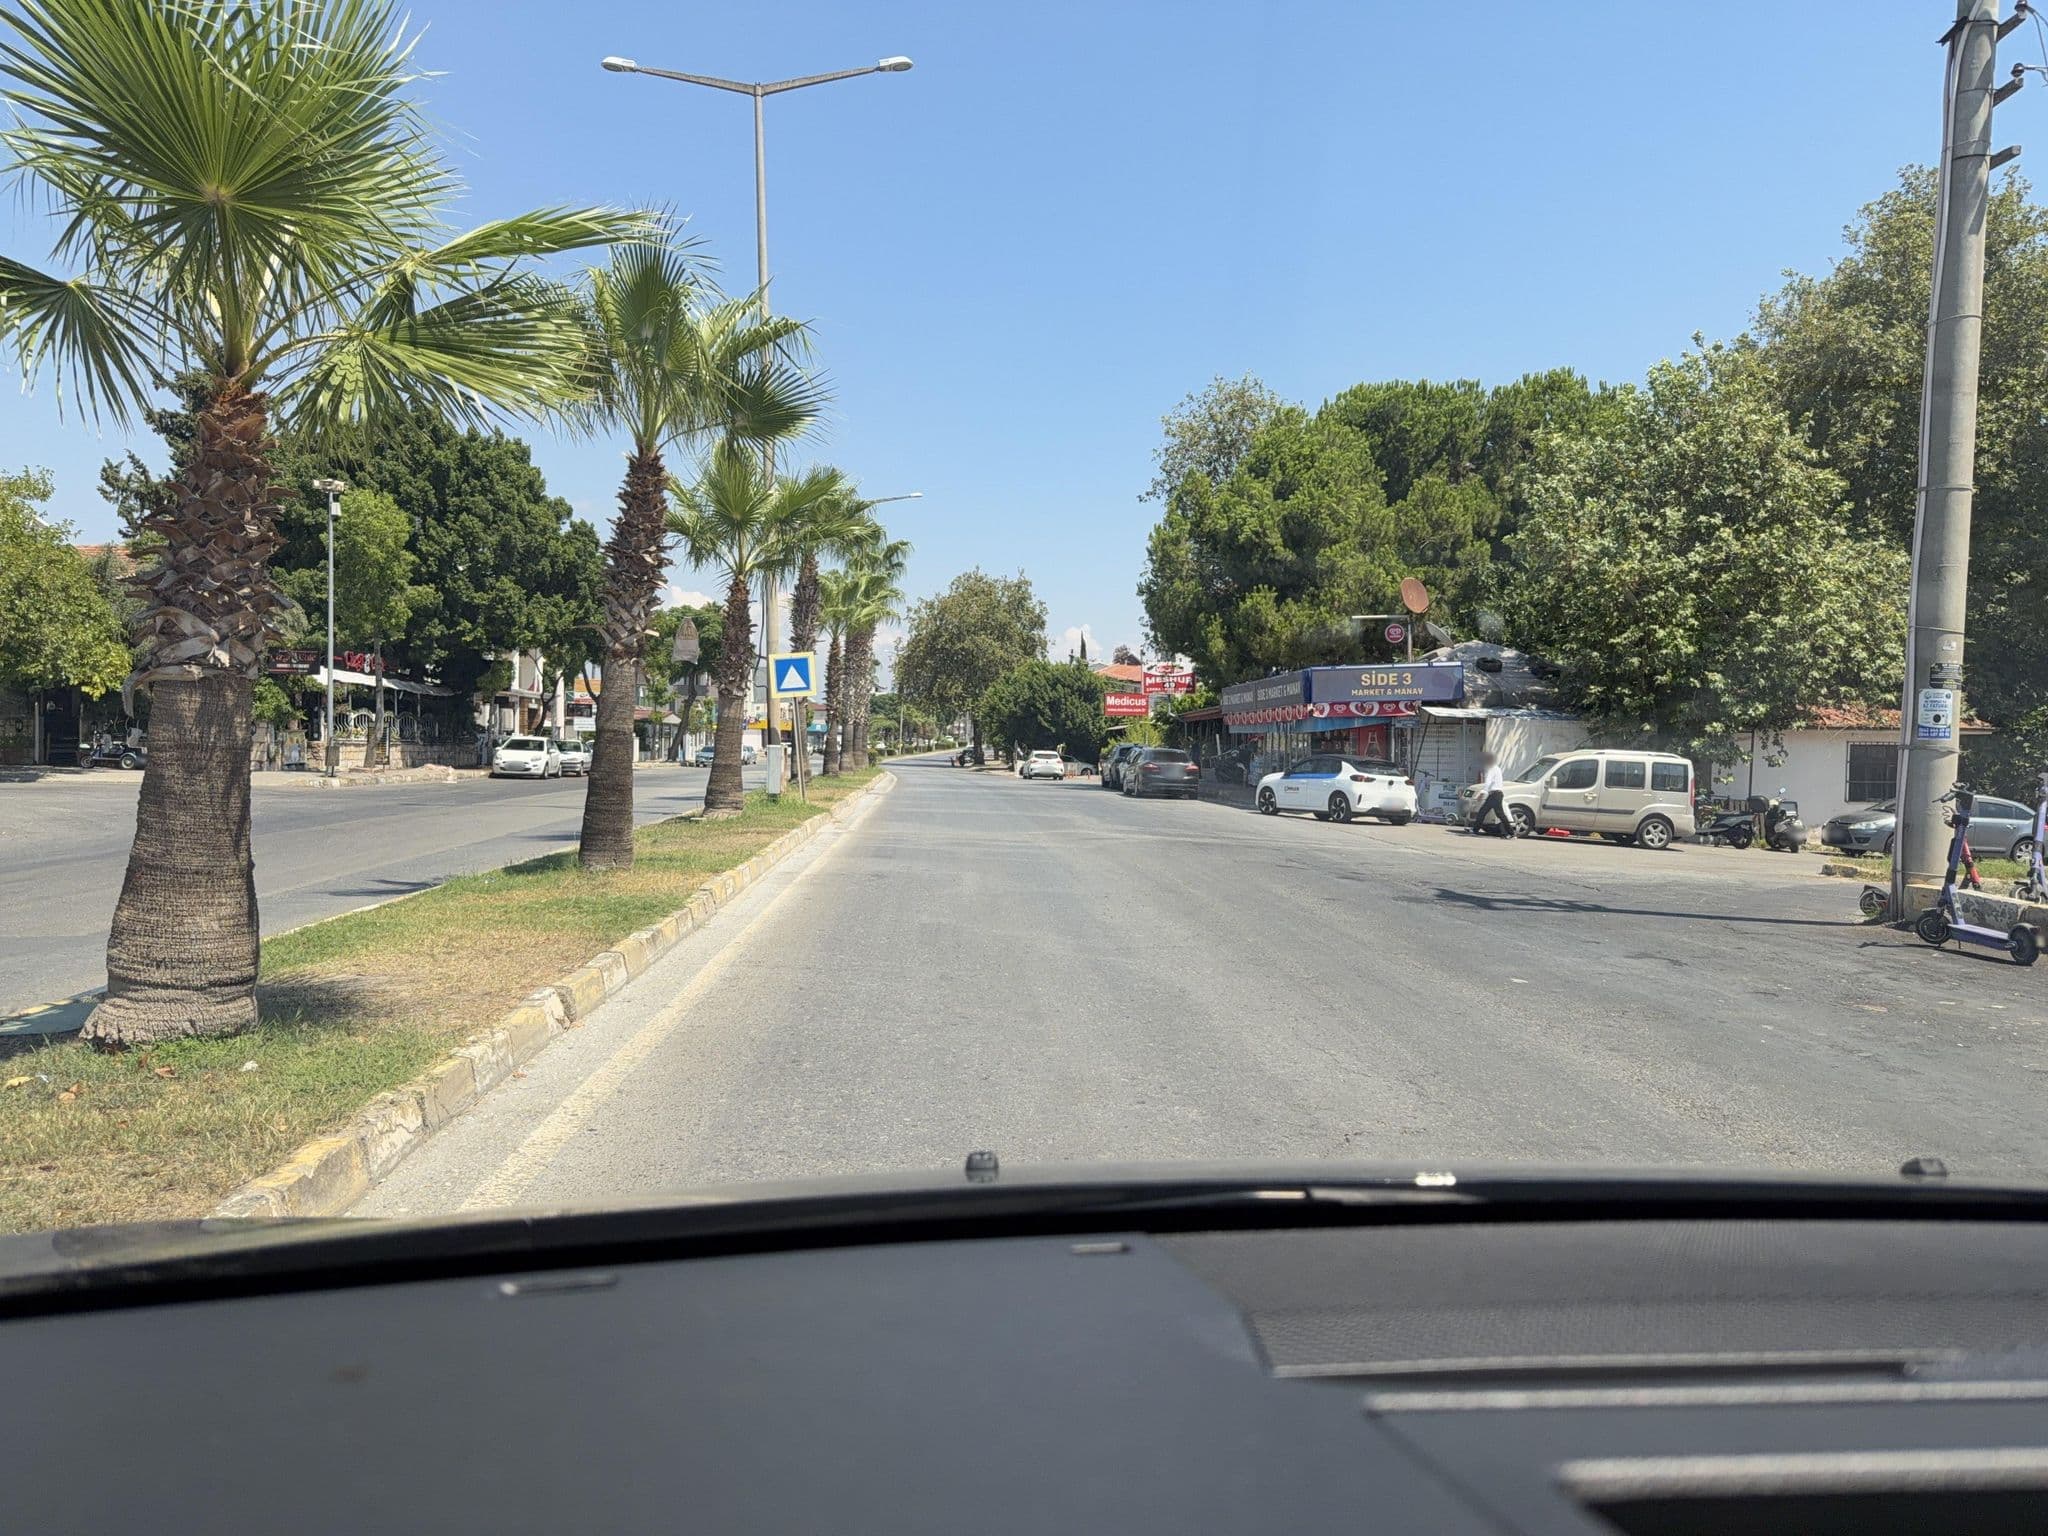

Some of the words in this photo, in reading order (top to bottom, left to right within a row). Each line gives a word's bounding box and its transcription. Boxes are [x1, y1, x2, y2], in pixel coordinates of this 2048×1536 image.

[1361, 670, 1398, 686] SİDE
[1403, 672, 1412, 685] 3
[1351, 688, 1384, 697] MARKET
[1386, 688, 1392, 696] &
[1394, 687, 1424, 696] MANAV
[1106, 696, 1147, 706] Medicus
